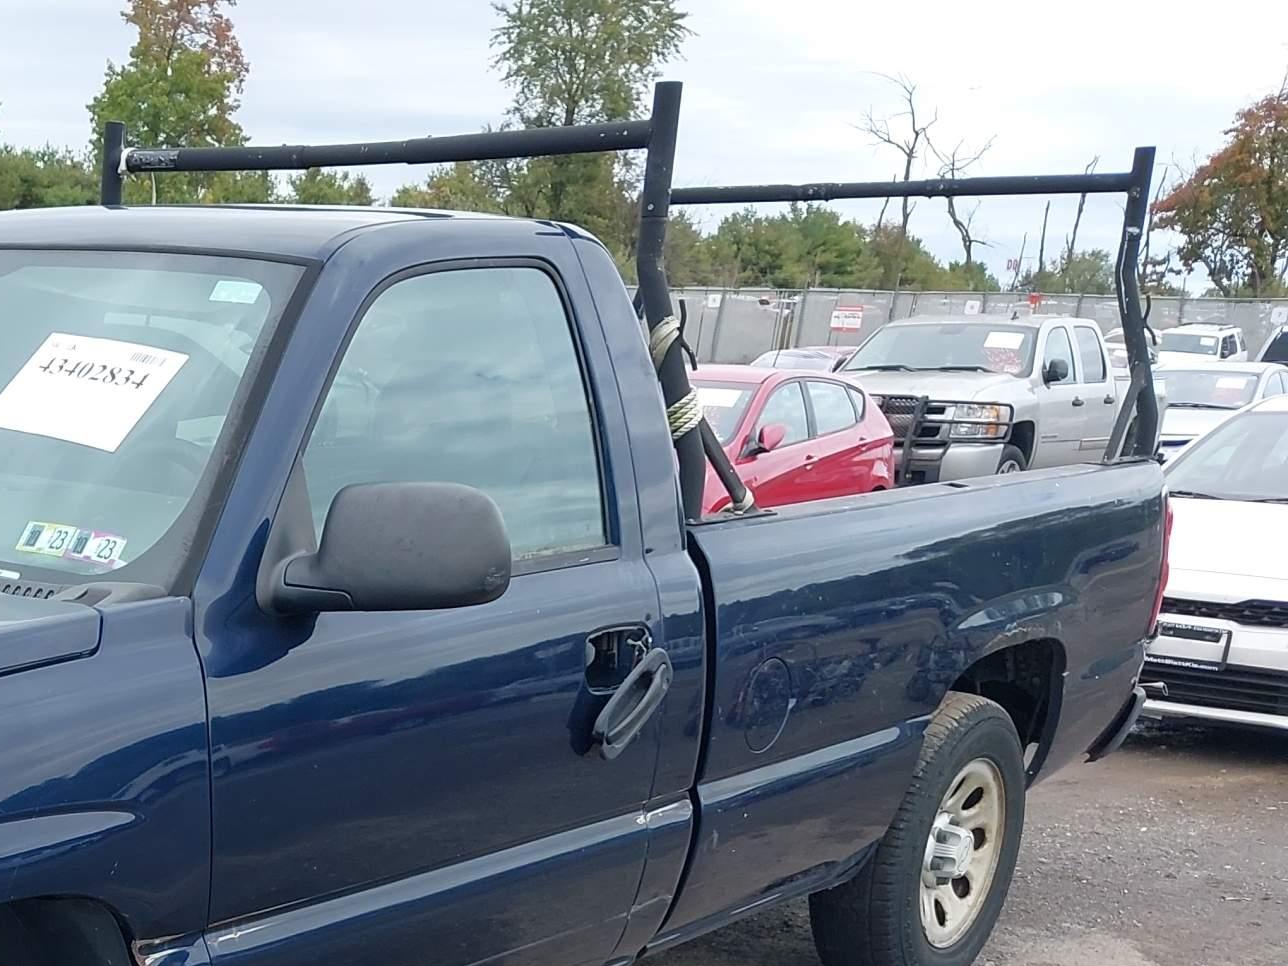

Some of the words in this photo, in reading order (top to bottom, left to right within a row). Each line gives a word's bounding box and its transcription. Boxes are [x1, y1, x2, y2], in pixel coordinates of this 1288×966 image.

[39, 357, 150, 389] 43402834
[49, 530, 69, 550] 23
[96, 538, 117, 560] 23
